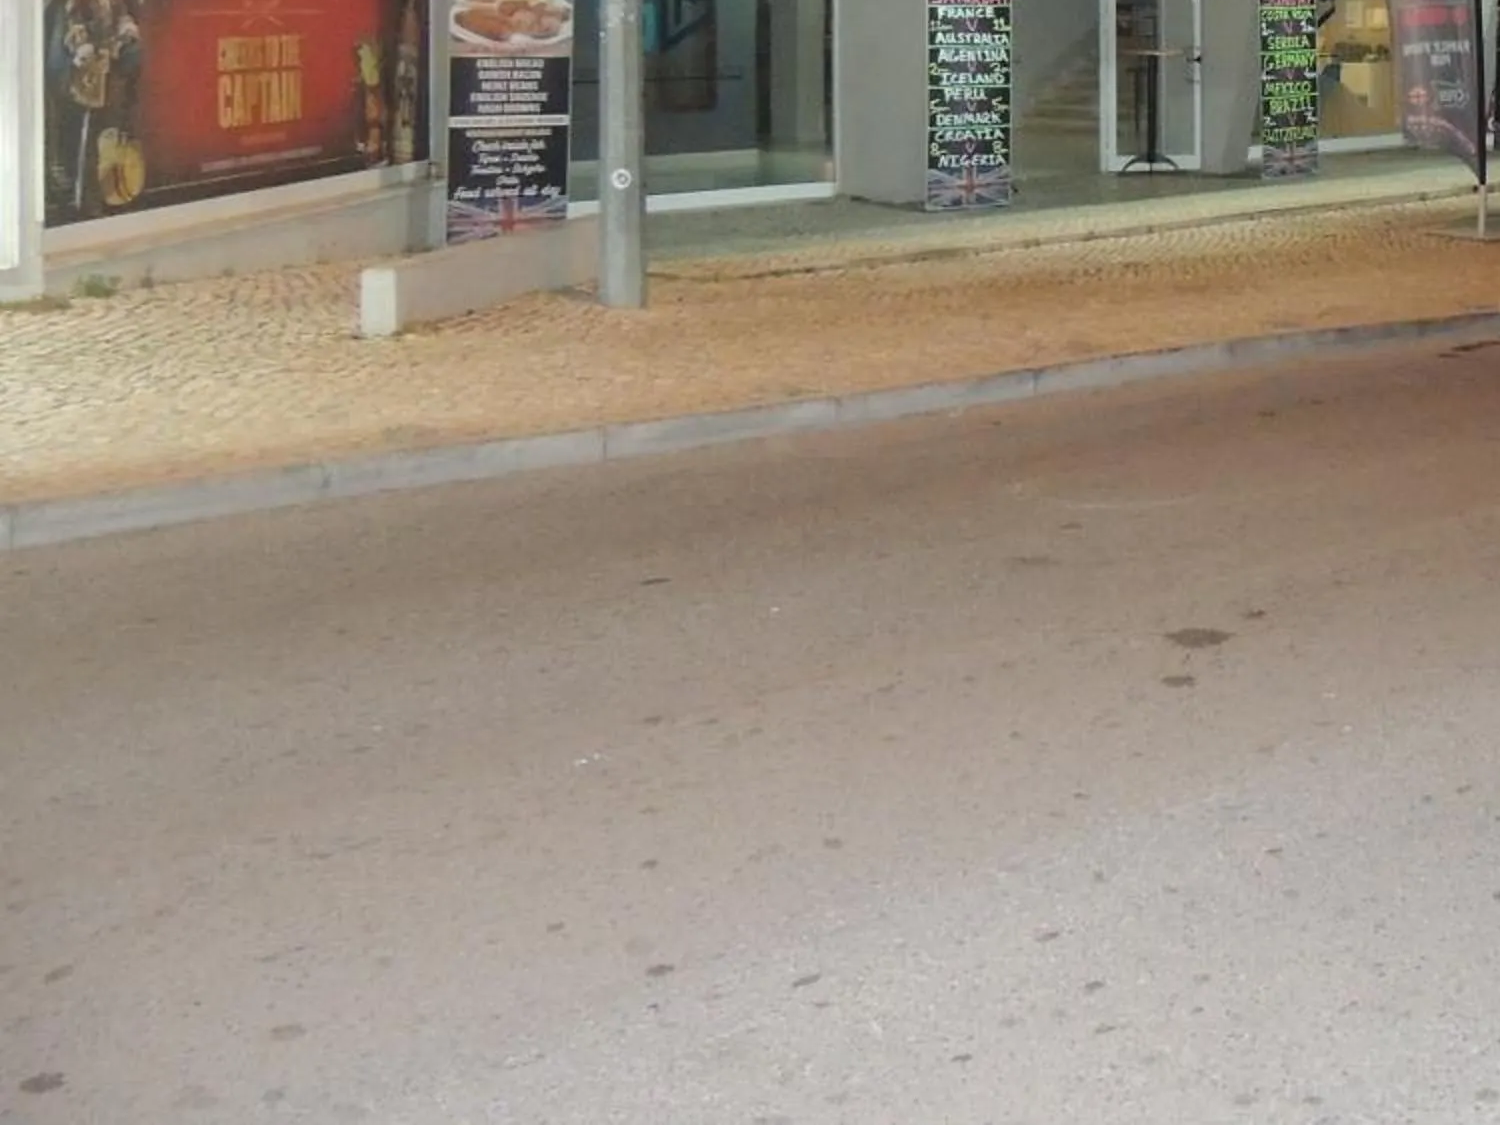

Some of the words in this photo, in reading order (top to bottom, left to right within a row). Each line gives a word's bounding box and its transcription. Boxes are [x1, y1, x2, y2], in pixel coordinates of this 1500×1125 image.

[937, 6, 996, 20] FRANCE
[935, 128, 1005, 142] CROATIA
[938, 154, 1006, 169] NIGERIA
